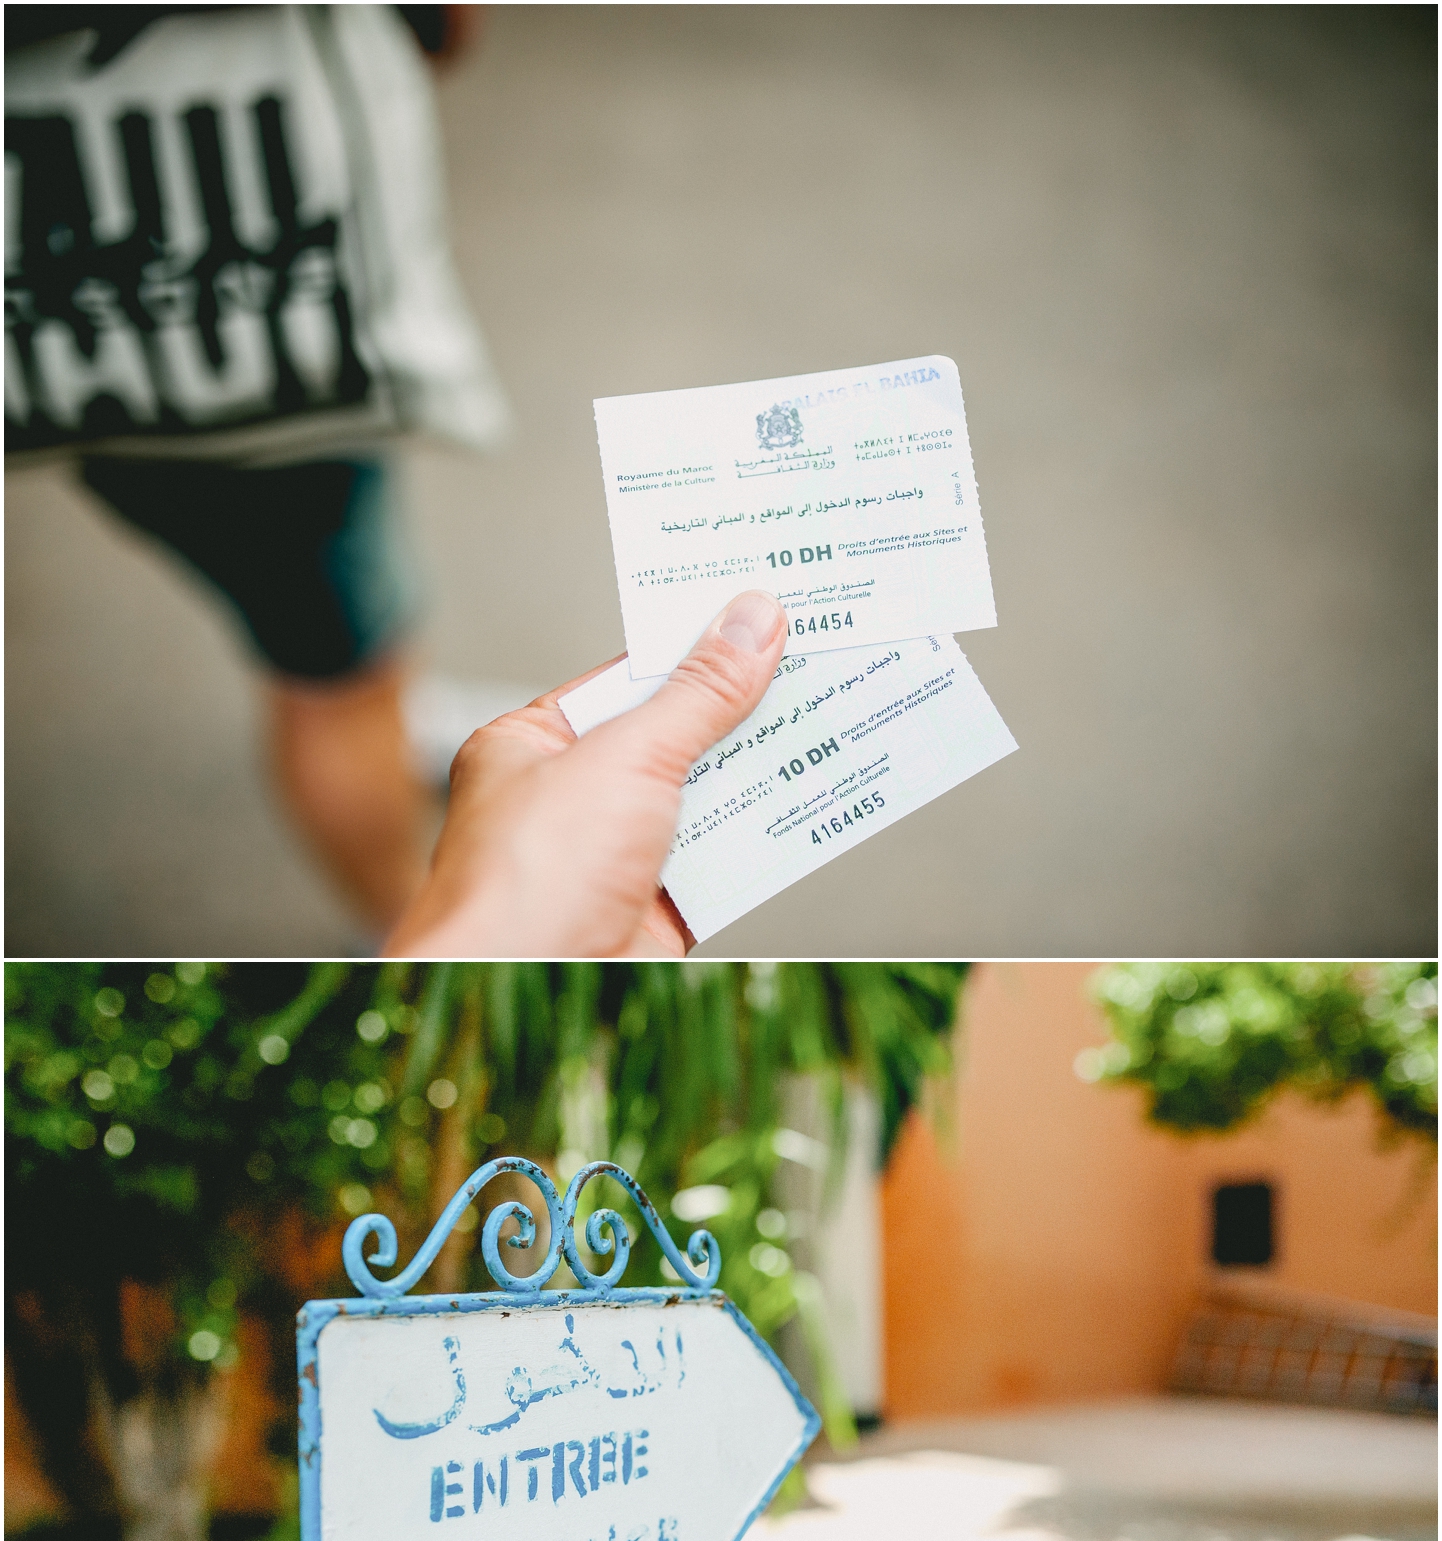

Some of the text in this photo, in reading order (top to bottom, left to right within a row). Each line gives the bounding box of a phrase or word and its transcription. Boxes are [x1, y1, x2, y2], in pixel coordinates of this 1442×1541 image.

[879, 367, 941, 390] BAHIA
[617, 465, 714, 482] Royaume du Maroc
[618, 484, 659, 493] Ministère
[684, 477, 716, 486] Culture
[815, 497, 851, 513] الدخول
[855, 497, 882, 509] رسوم
[886, 487, 924, 501] واجبات
[954, 482, 964, 506] Série
[661, 518, 708, 534] التاريخية
[712, 513, 745, 531] المباني
[749, 514, 755, 524] و
[760, 506, 793, 524] المواقع
[837, 541, 867, 551] Droits
[933, 528, 955, 537] Sites
[846, 536, 962, 557] Monuments Historiques
[765, 544, 833, 569] 10 DH
[790, 600, 808, 610] pour
[837, 590, 872, 602] Culturelle
[866, 651, 901, 675] واجبات
[839, 673, 865, 694] رسوم
[805, 686, 836, 713] الدخول
[840, 720, 867, 740] Droits
[906, 687, 922, 701] aux
[923, 675, 944, 691] Sites
[945, 668, 955, 678] et
[851, 679, 953, 743] Monuments Historiques
[755, 716, 786, 744] المواقع
[747, 738, 754, 749] و
[714, 741, 744, 770] المباني
[777, 737, 841, 782] 10 DH
[857, 752, 890, 777] الصندوق
[830, 772, 857, 795] الوطني
[772, 824, 793, 839] Fonds
[791, 807, 820, 827] National
[819, 798, 835, 812] pour
[859, 766, 891, 787] Culturelle
[811, 790, 885, 845] 4164455
[373, 1314, 686, 1438] الدخول
[428, 1428, 650, 1523] ENTREE
